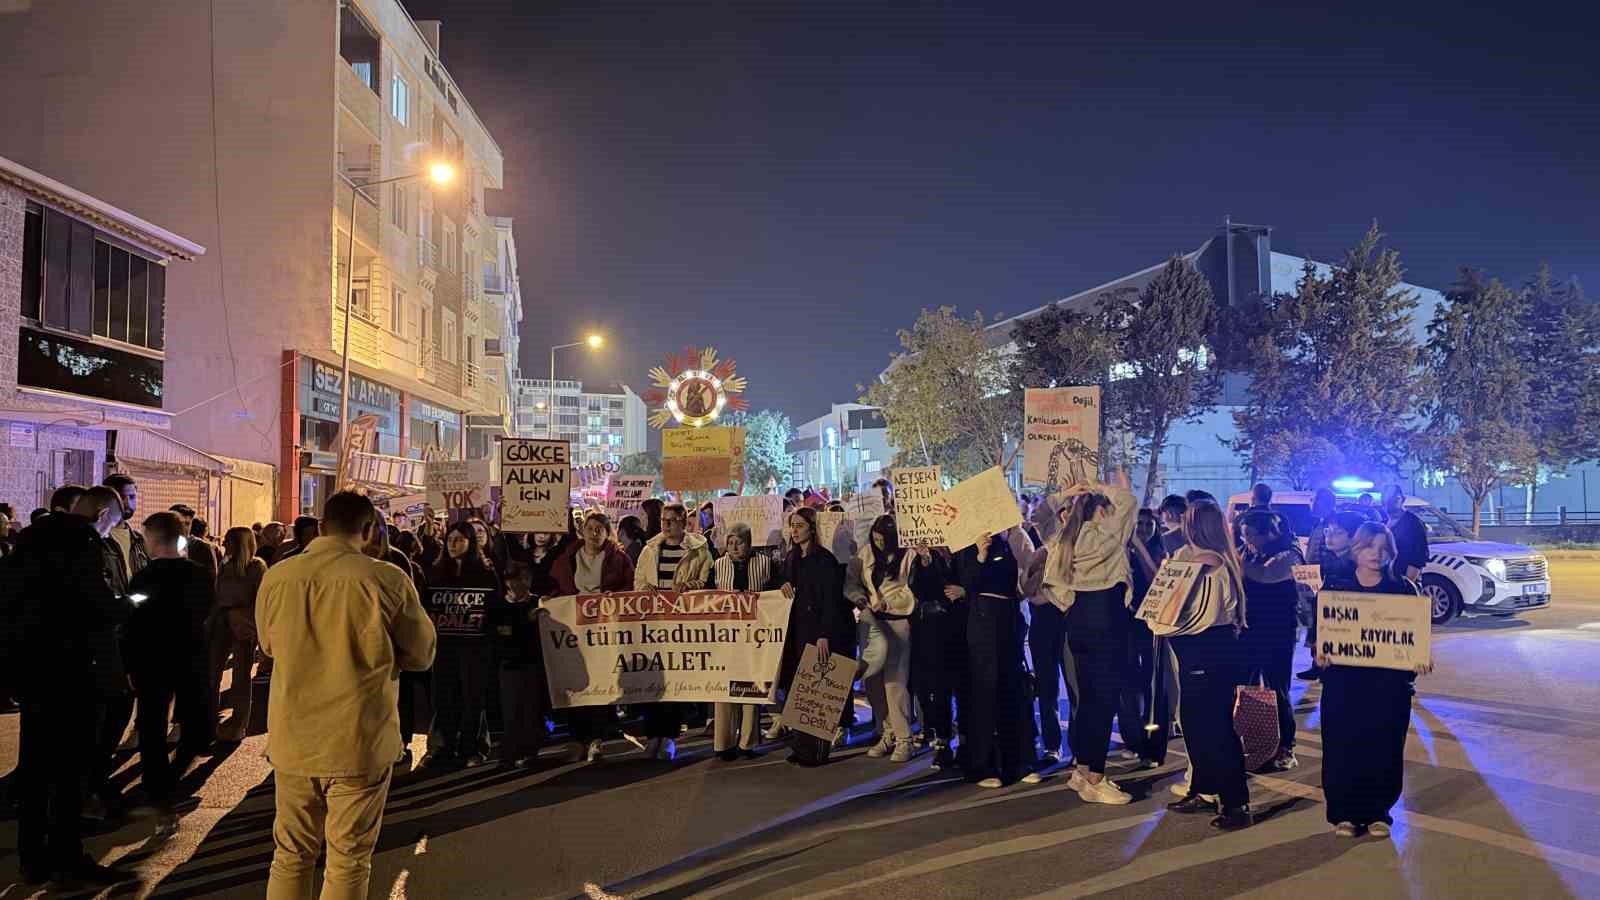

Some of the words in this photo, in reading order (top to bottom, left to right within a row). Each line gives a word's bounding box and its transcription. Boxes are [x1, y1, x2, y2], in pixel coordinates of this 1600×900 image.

[507, 441, 565, 464] GÖKÇE
[506, 468, 564, 485] ALKAN
[442, 490, 474, 509] YOK
[911, 516, 927, 528] YA
[431, 591, 485, 608] GÖKÇE
[581, 591, 665, 620] GÖKÇE
[671, 593, 758, 615] ALKAN
[1322, 605, 1359, 624] BAŞKA
[550, 631, 579, 649] Ve
[586, 628, 633, 647] tüm
[641, 623, 740, 645] kadınlar
[745, 623, 783, 649] için
[1322, 640, 1377, 659] OLMASIN
[612, 651, 727, 674] ADALET...
